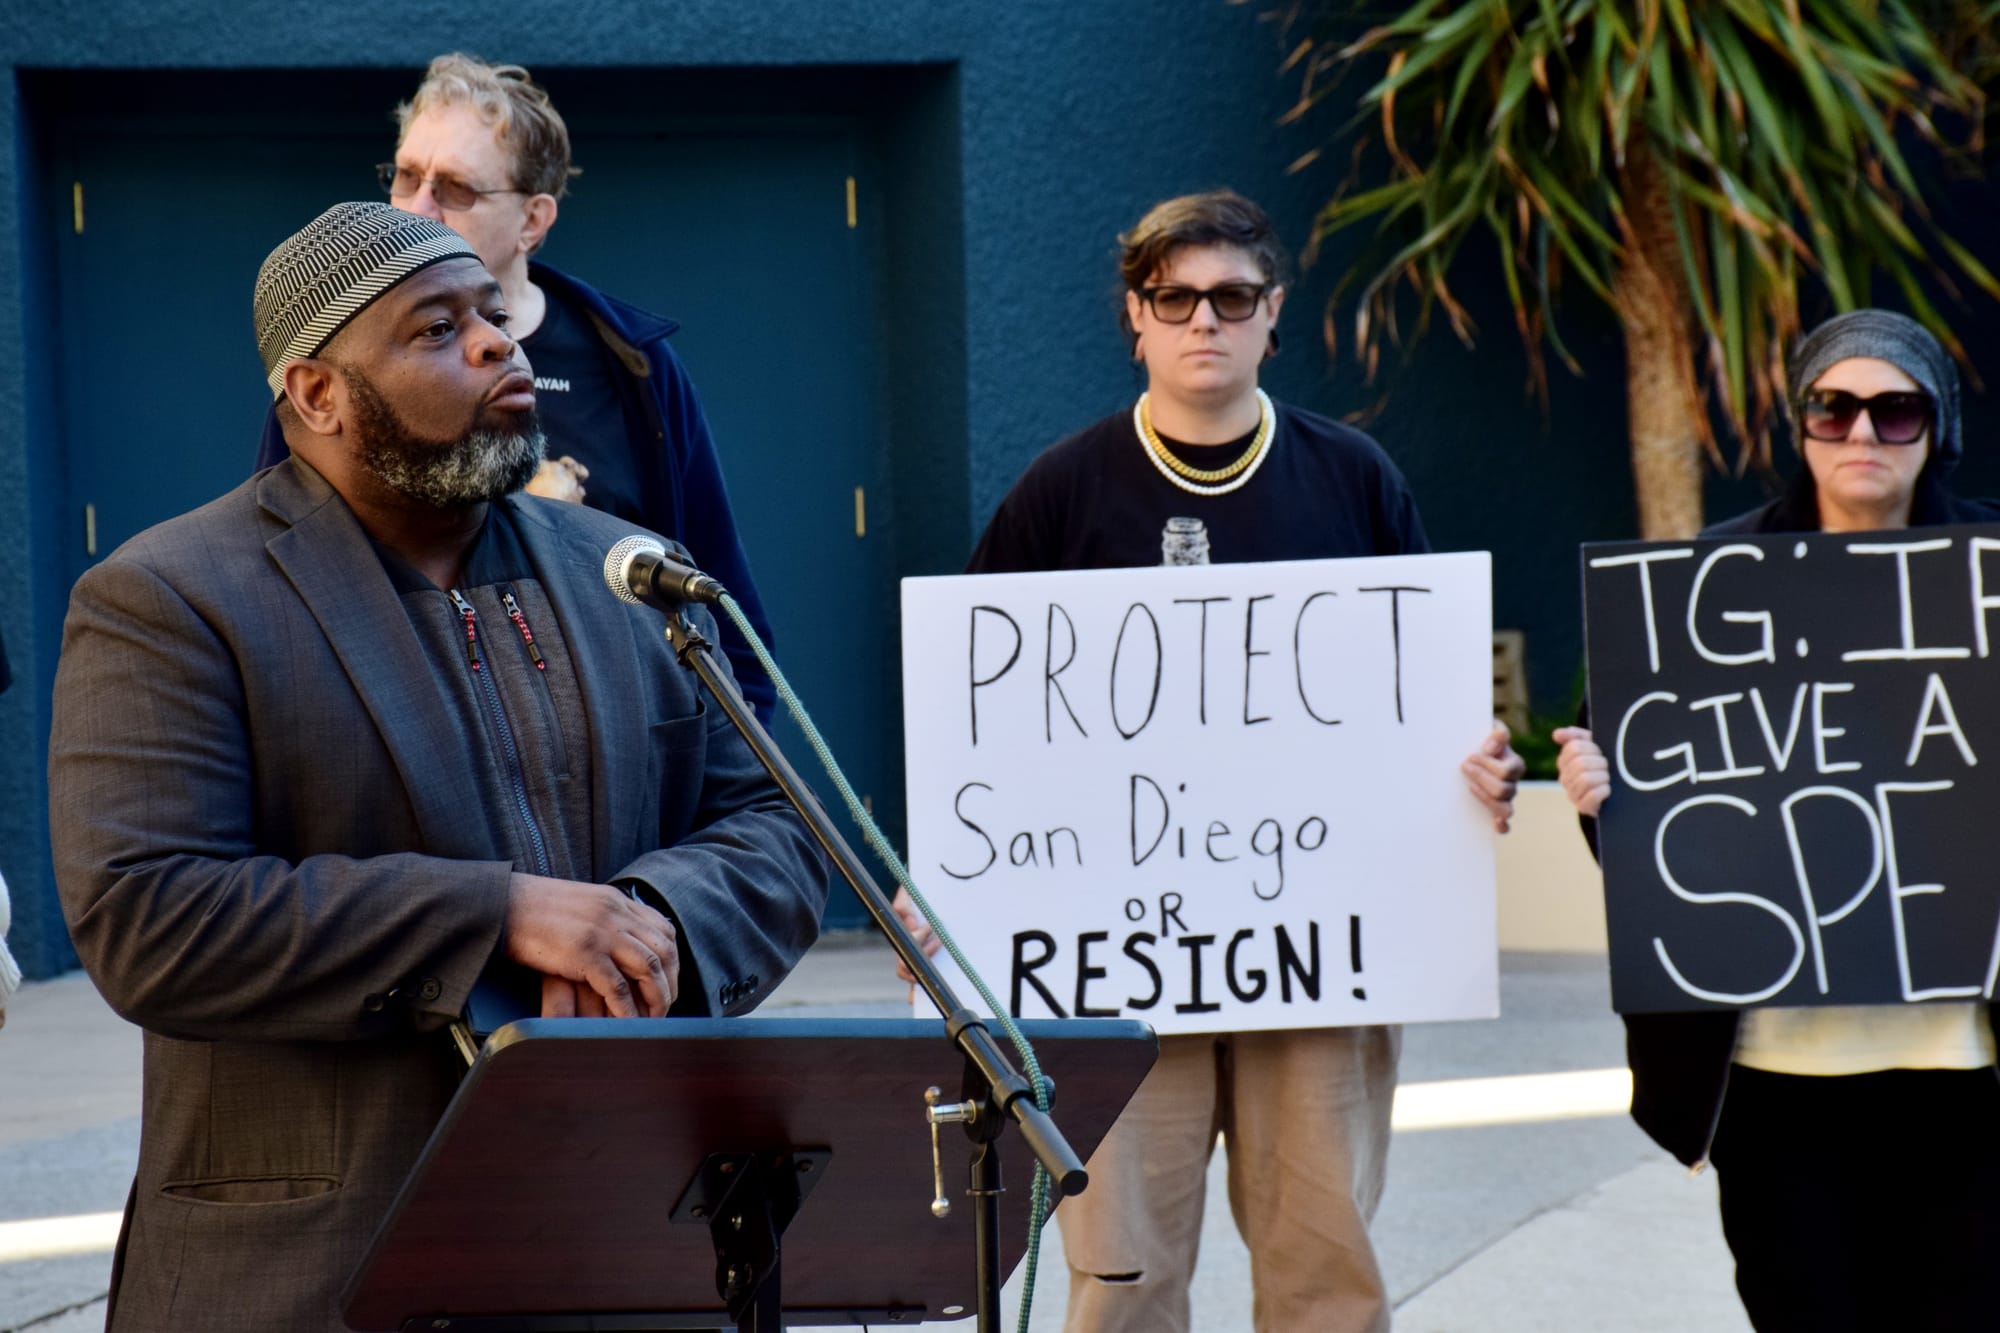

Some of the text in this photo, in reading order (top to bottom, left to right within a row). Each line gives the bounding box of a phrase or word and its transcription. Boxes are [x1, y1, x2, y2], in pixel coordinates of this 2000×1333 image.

[970, 586, 1431, 747] PROTECT
[1590, 541, 1809, 673] TG:
[1615, 672, 1978, 791] GIVE A
[940, 774, 1328, 901] San Diego
[1010, 914, 1368, 1018] RESIGN!
[1124, 892, 1189, 937] OR
